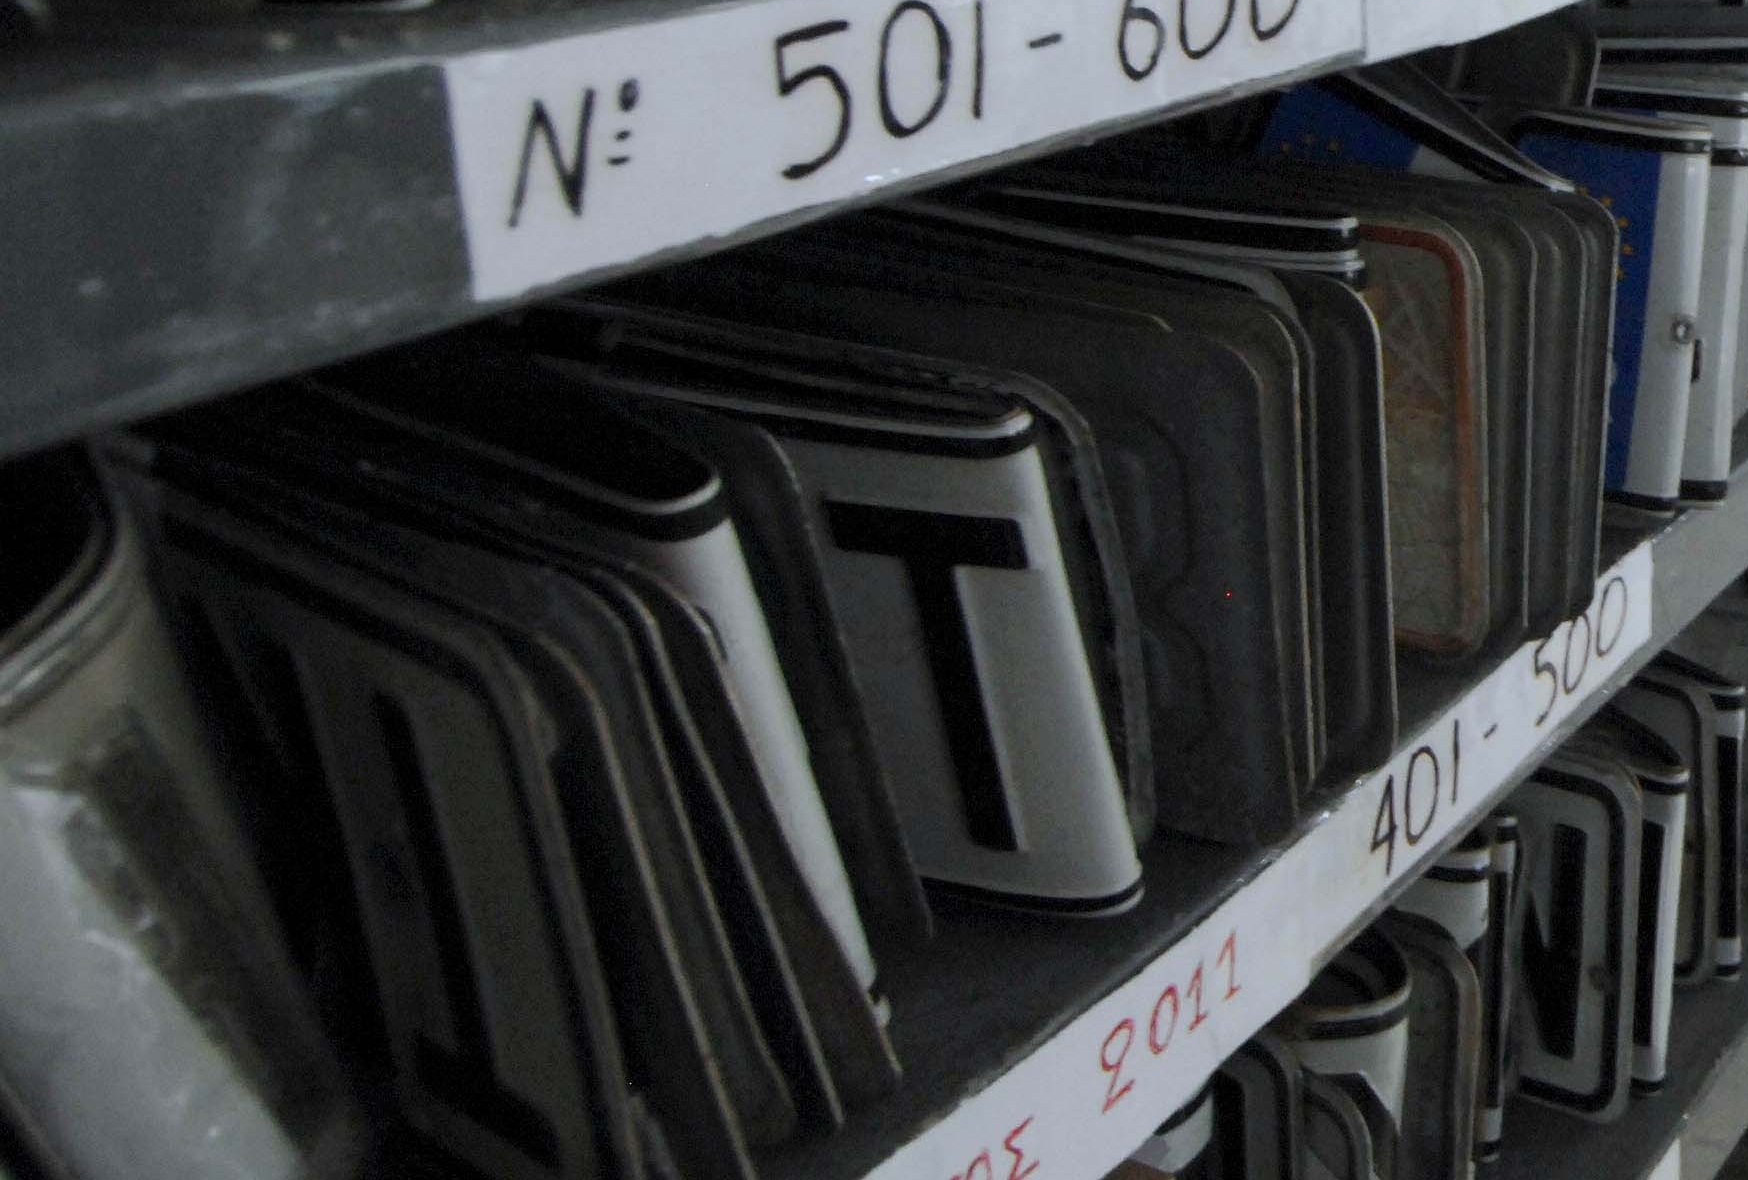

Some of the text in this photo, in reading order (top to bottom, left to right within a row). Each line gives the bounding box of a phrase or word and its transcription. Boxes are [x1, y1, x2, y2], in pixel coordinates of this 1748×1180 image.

[1369, 718, 1461, 877] 401
[1533, 575, 1628, 728] 500
[1100, 930, 1242, 1115] 2011
